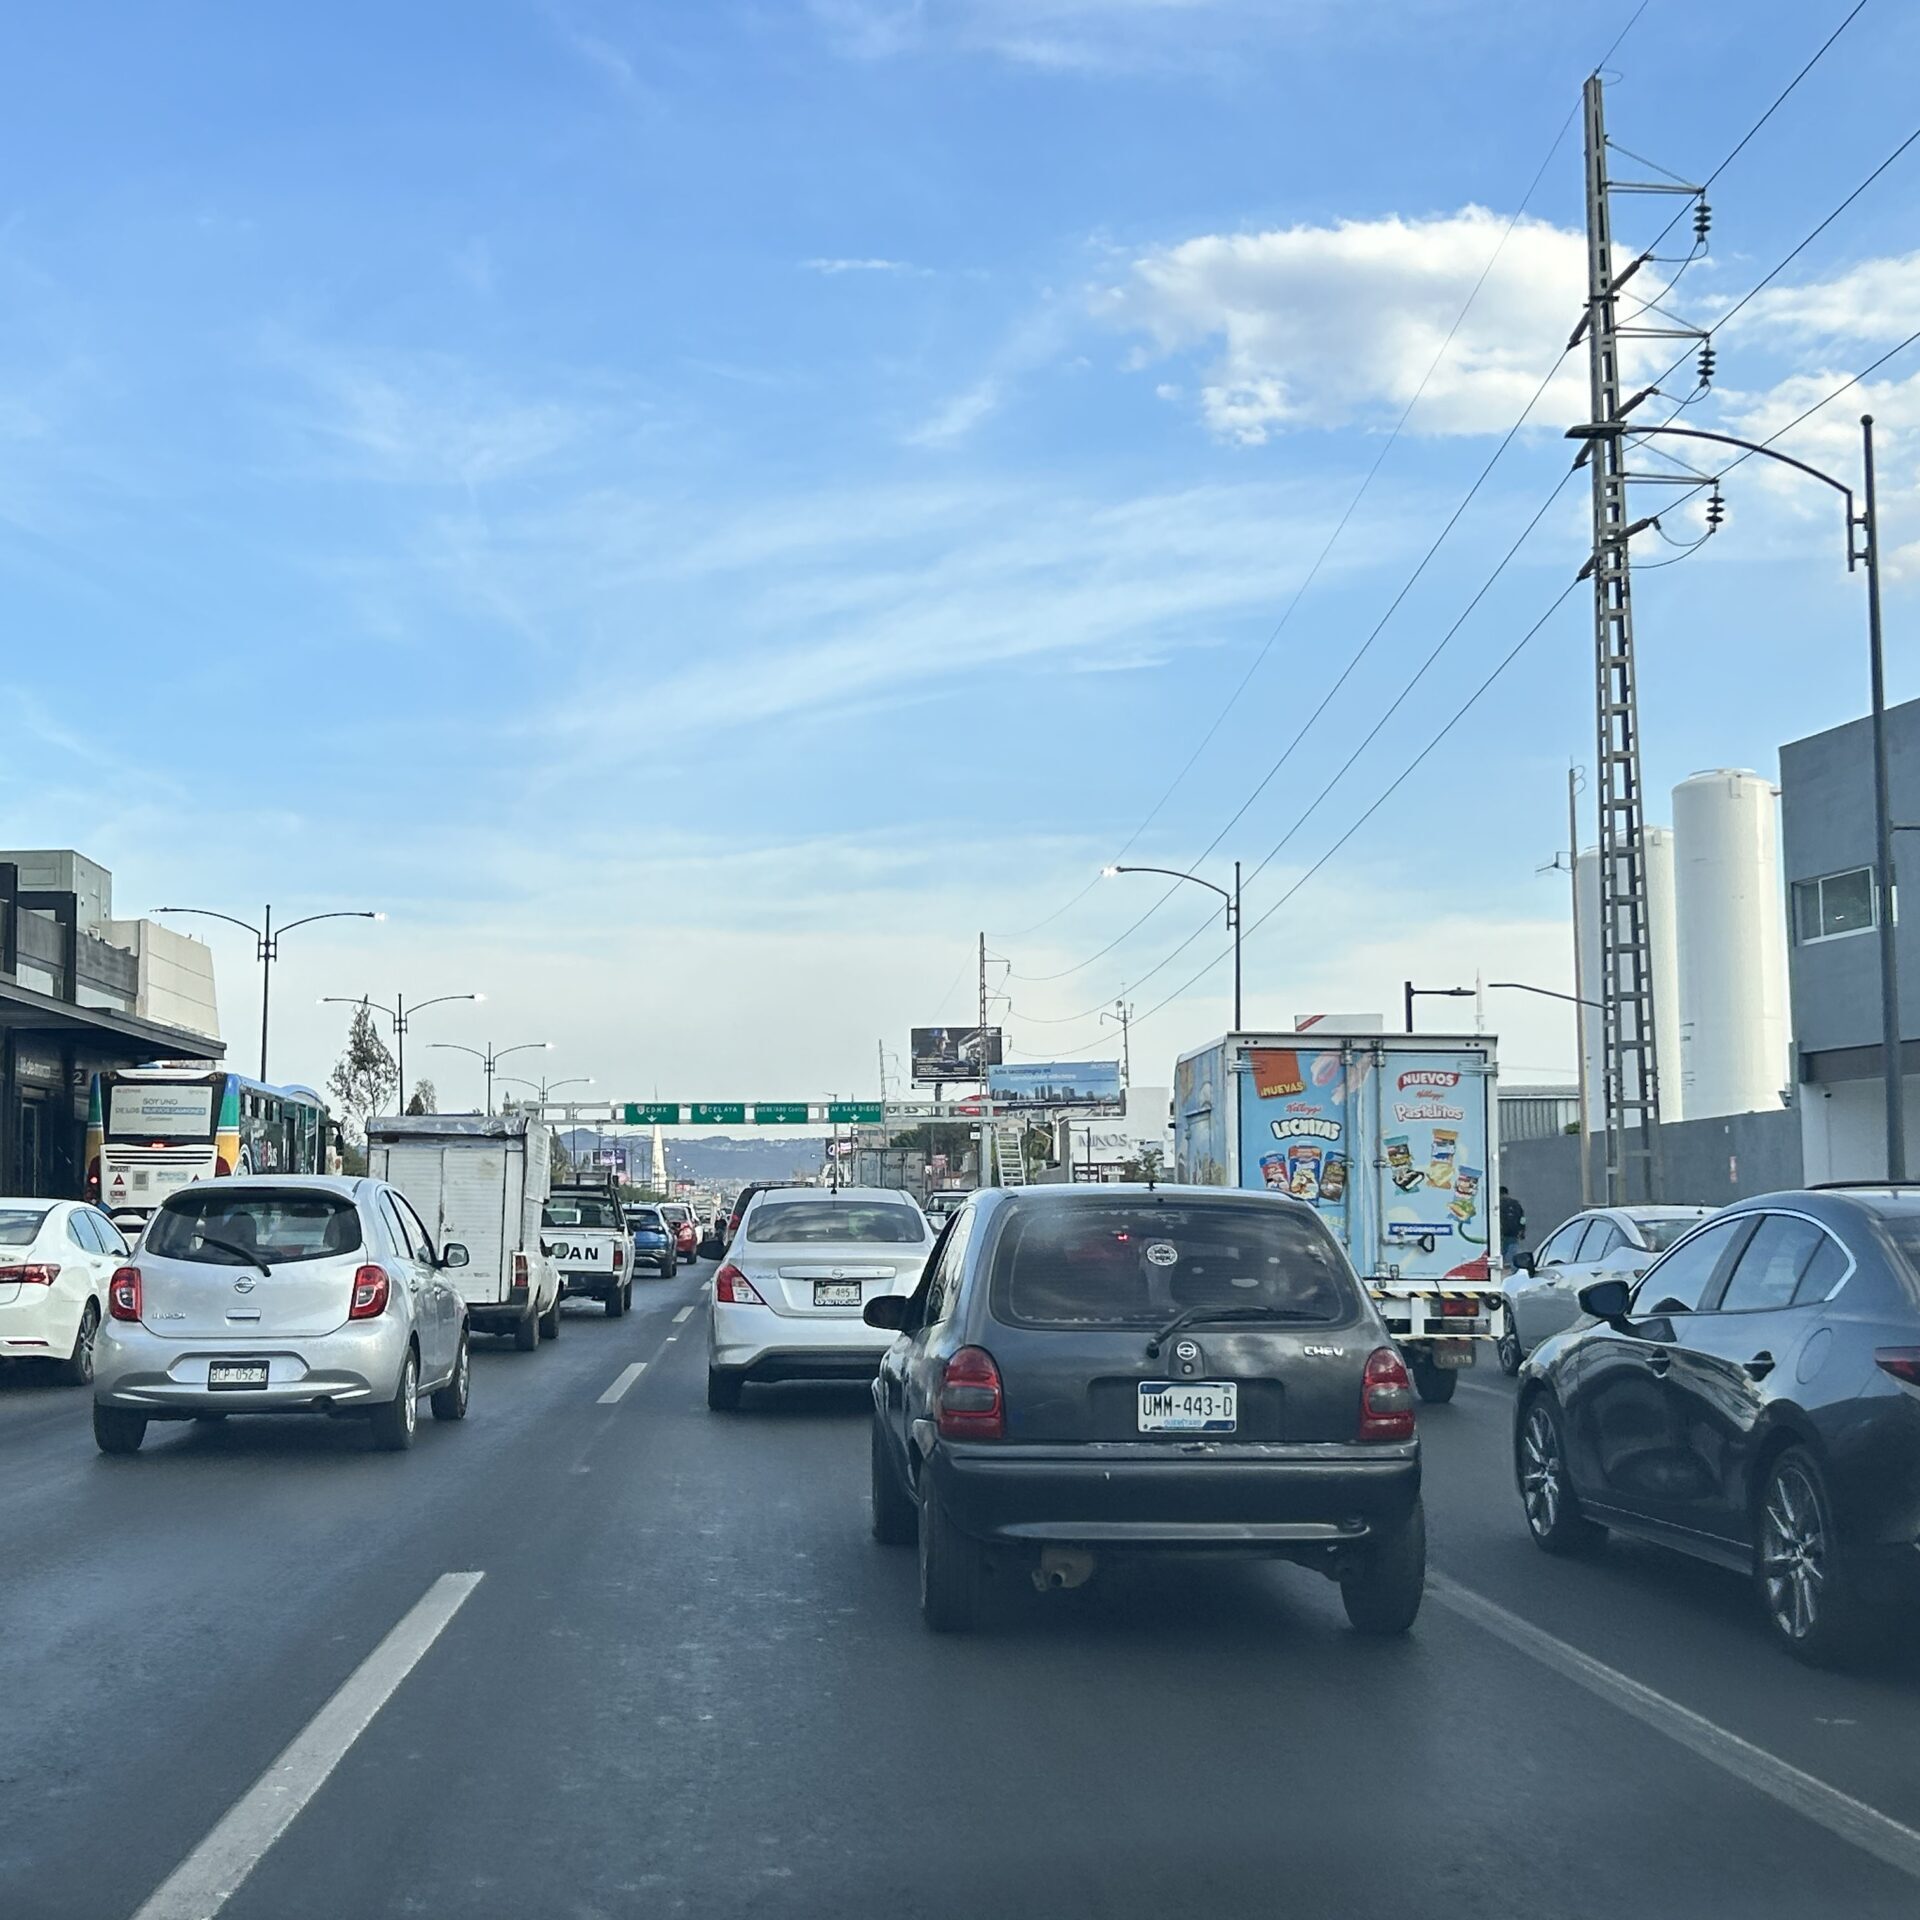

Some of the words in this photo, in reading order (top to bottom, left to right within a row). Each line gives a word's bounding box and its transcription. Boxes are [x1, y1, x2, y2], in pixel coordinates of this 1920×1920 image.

[73, 1071, 83, 1084] 2
[1403, 1072, 1455, 1086] NUEVOS
[645, 1106, 668, 1114] CDMX
[1394, 1104, 1464, 1122] Pastelitos
[1304, 1346, 1344, 1356] CHEV
[1143, 1395, 1233, 1416] UMM-443-D
